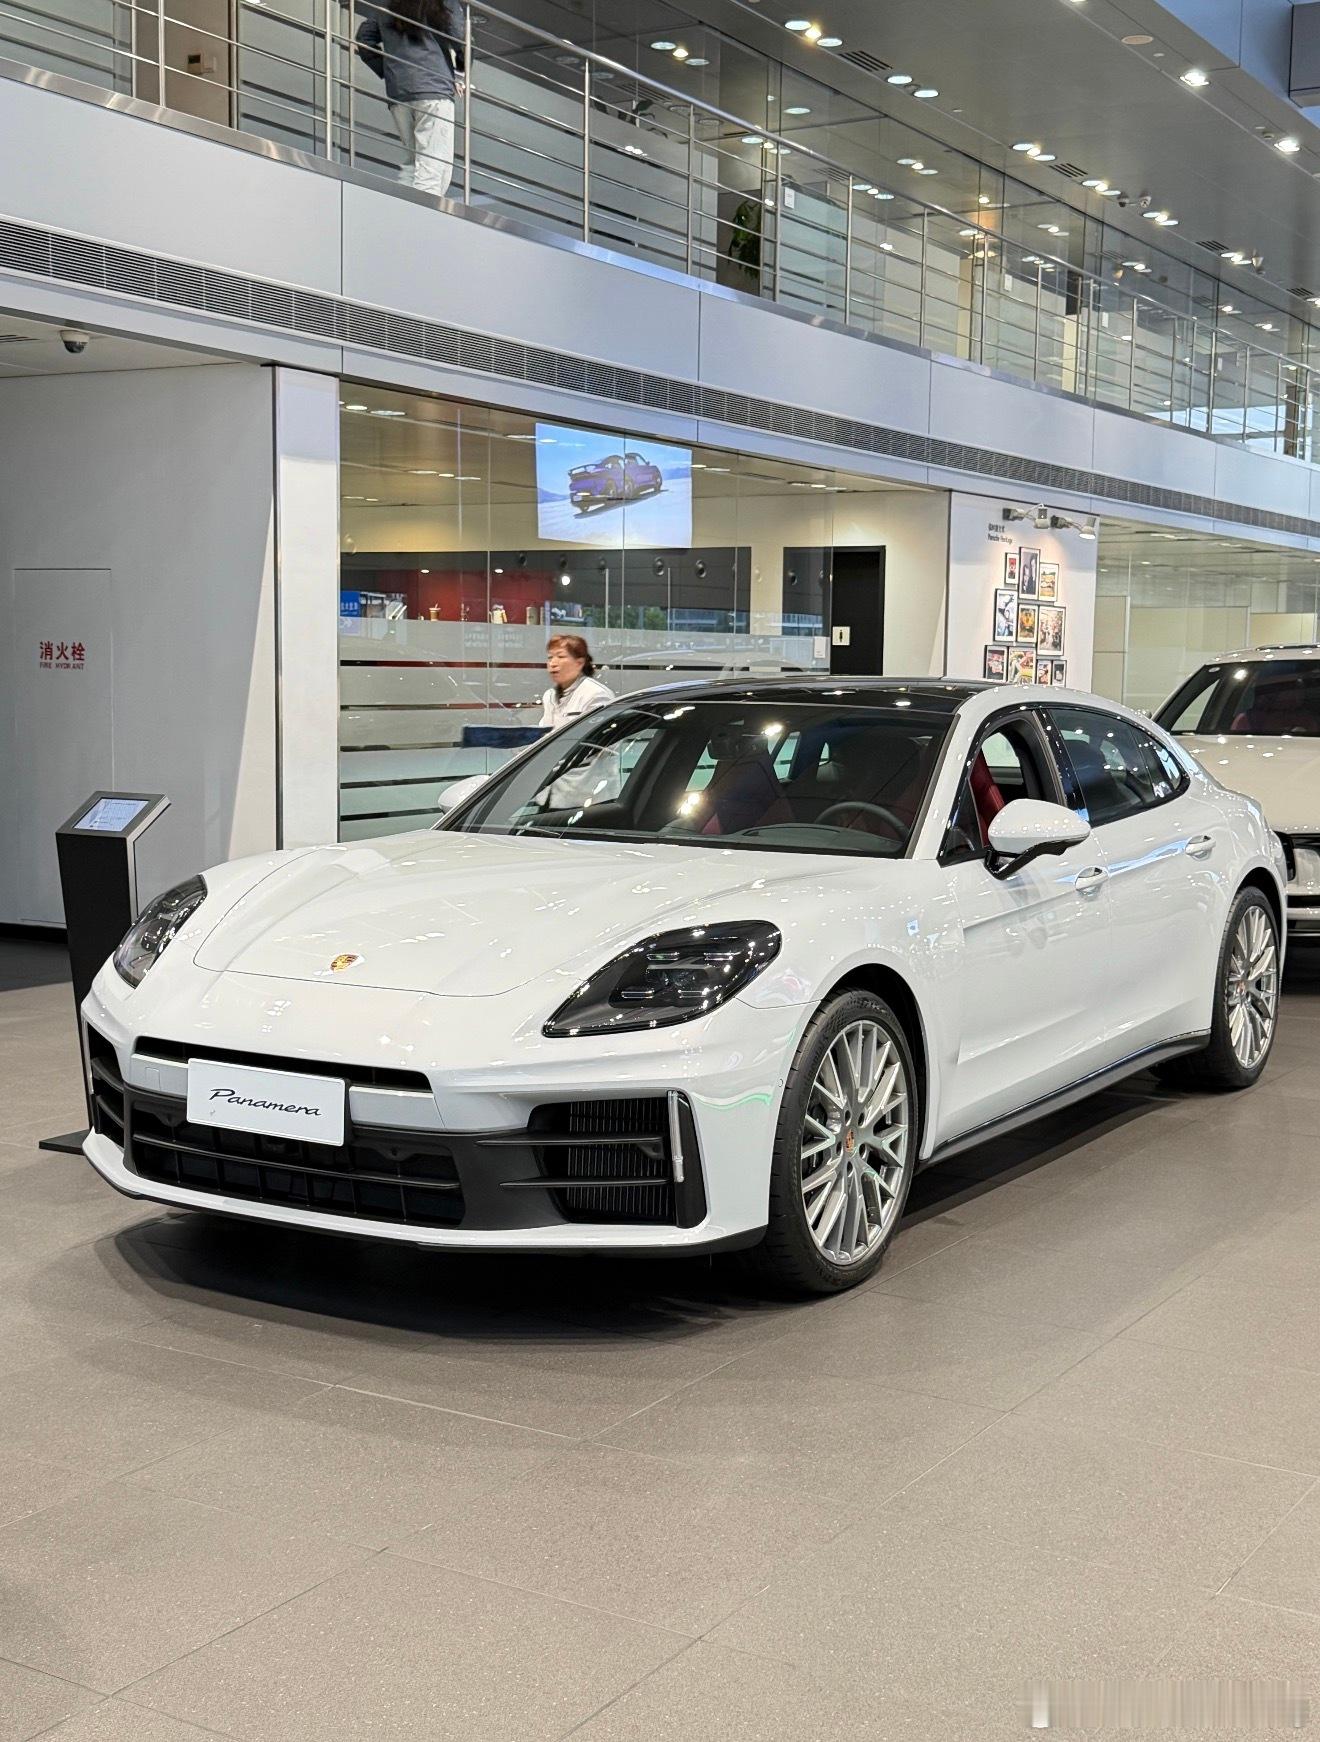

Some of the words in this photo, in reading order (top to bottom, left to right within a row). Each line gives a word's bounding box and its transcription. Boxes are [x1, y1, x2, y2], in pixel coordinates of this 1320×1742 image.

[40, 641, 86, 661] 消火栓
[209, 1088, 322, 1117] Panamera
